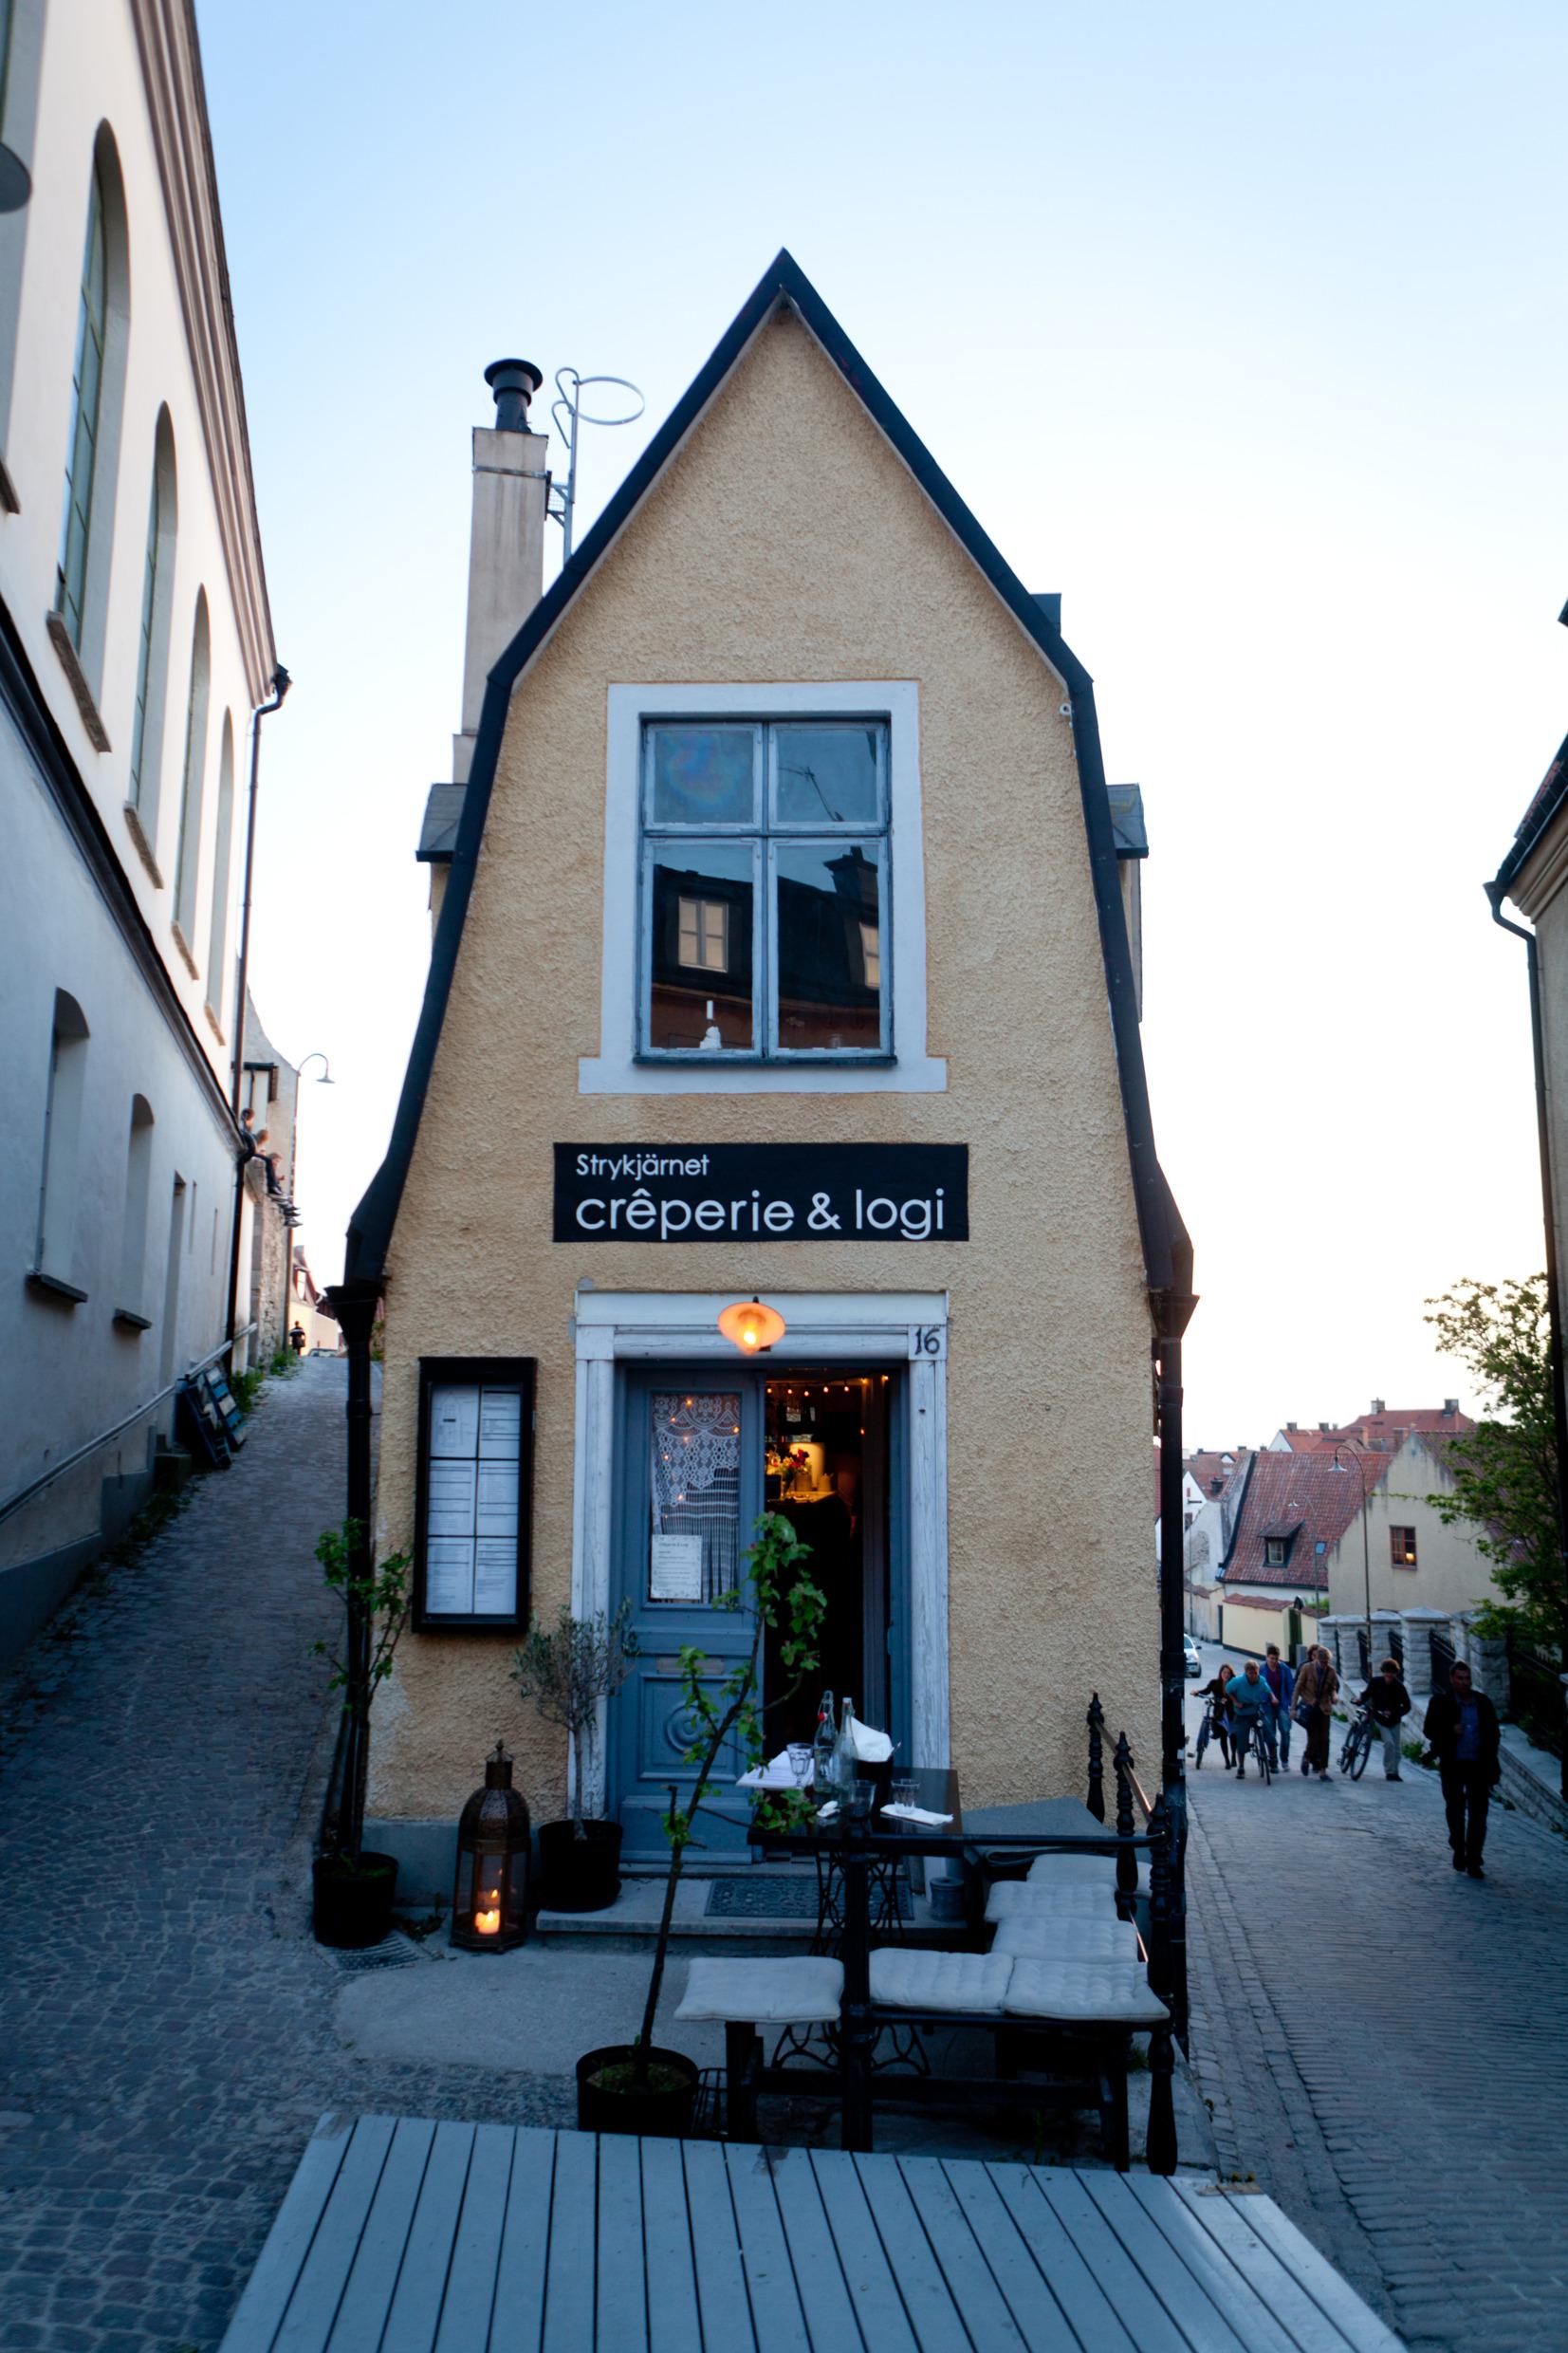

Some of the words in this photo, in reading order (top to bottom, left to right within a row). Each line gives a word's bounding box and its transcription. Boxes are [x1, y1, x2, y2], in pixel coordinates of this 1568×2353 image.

[576, 1154, 710, 1181] Strykjärnet
[576, 1188, 795, 1239] crêperie
[806, 1192, 841, 1231] &
[856, 1188, 944, 1240] logi
[914, 1327, 940, 1355] 16
